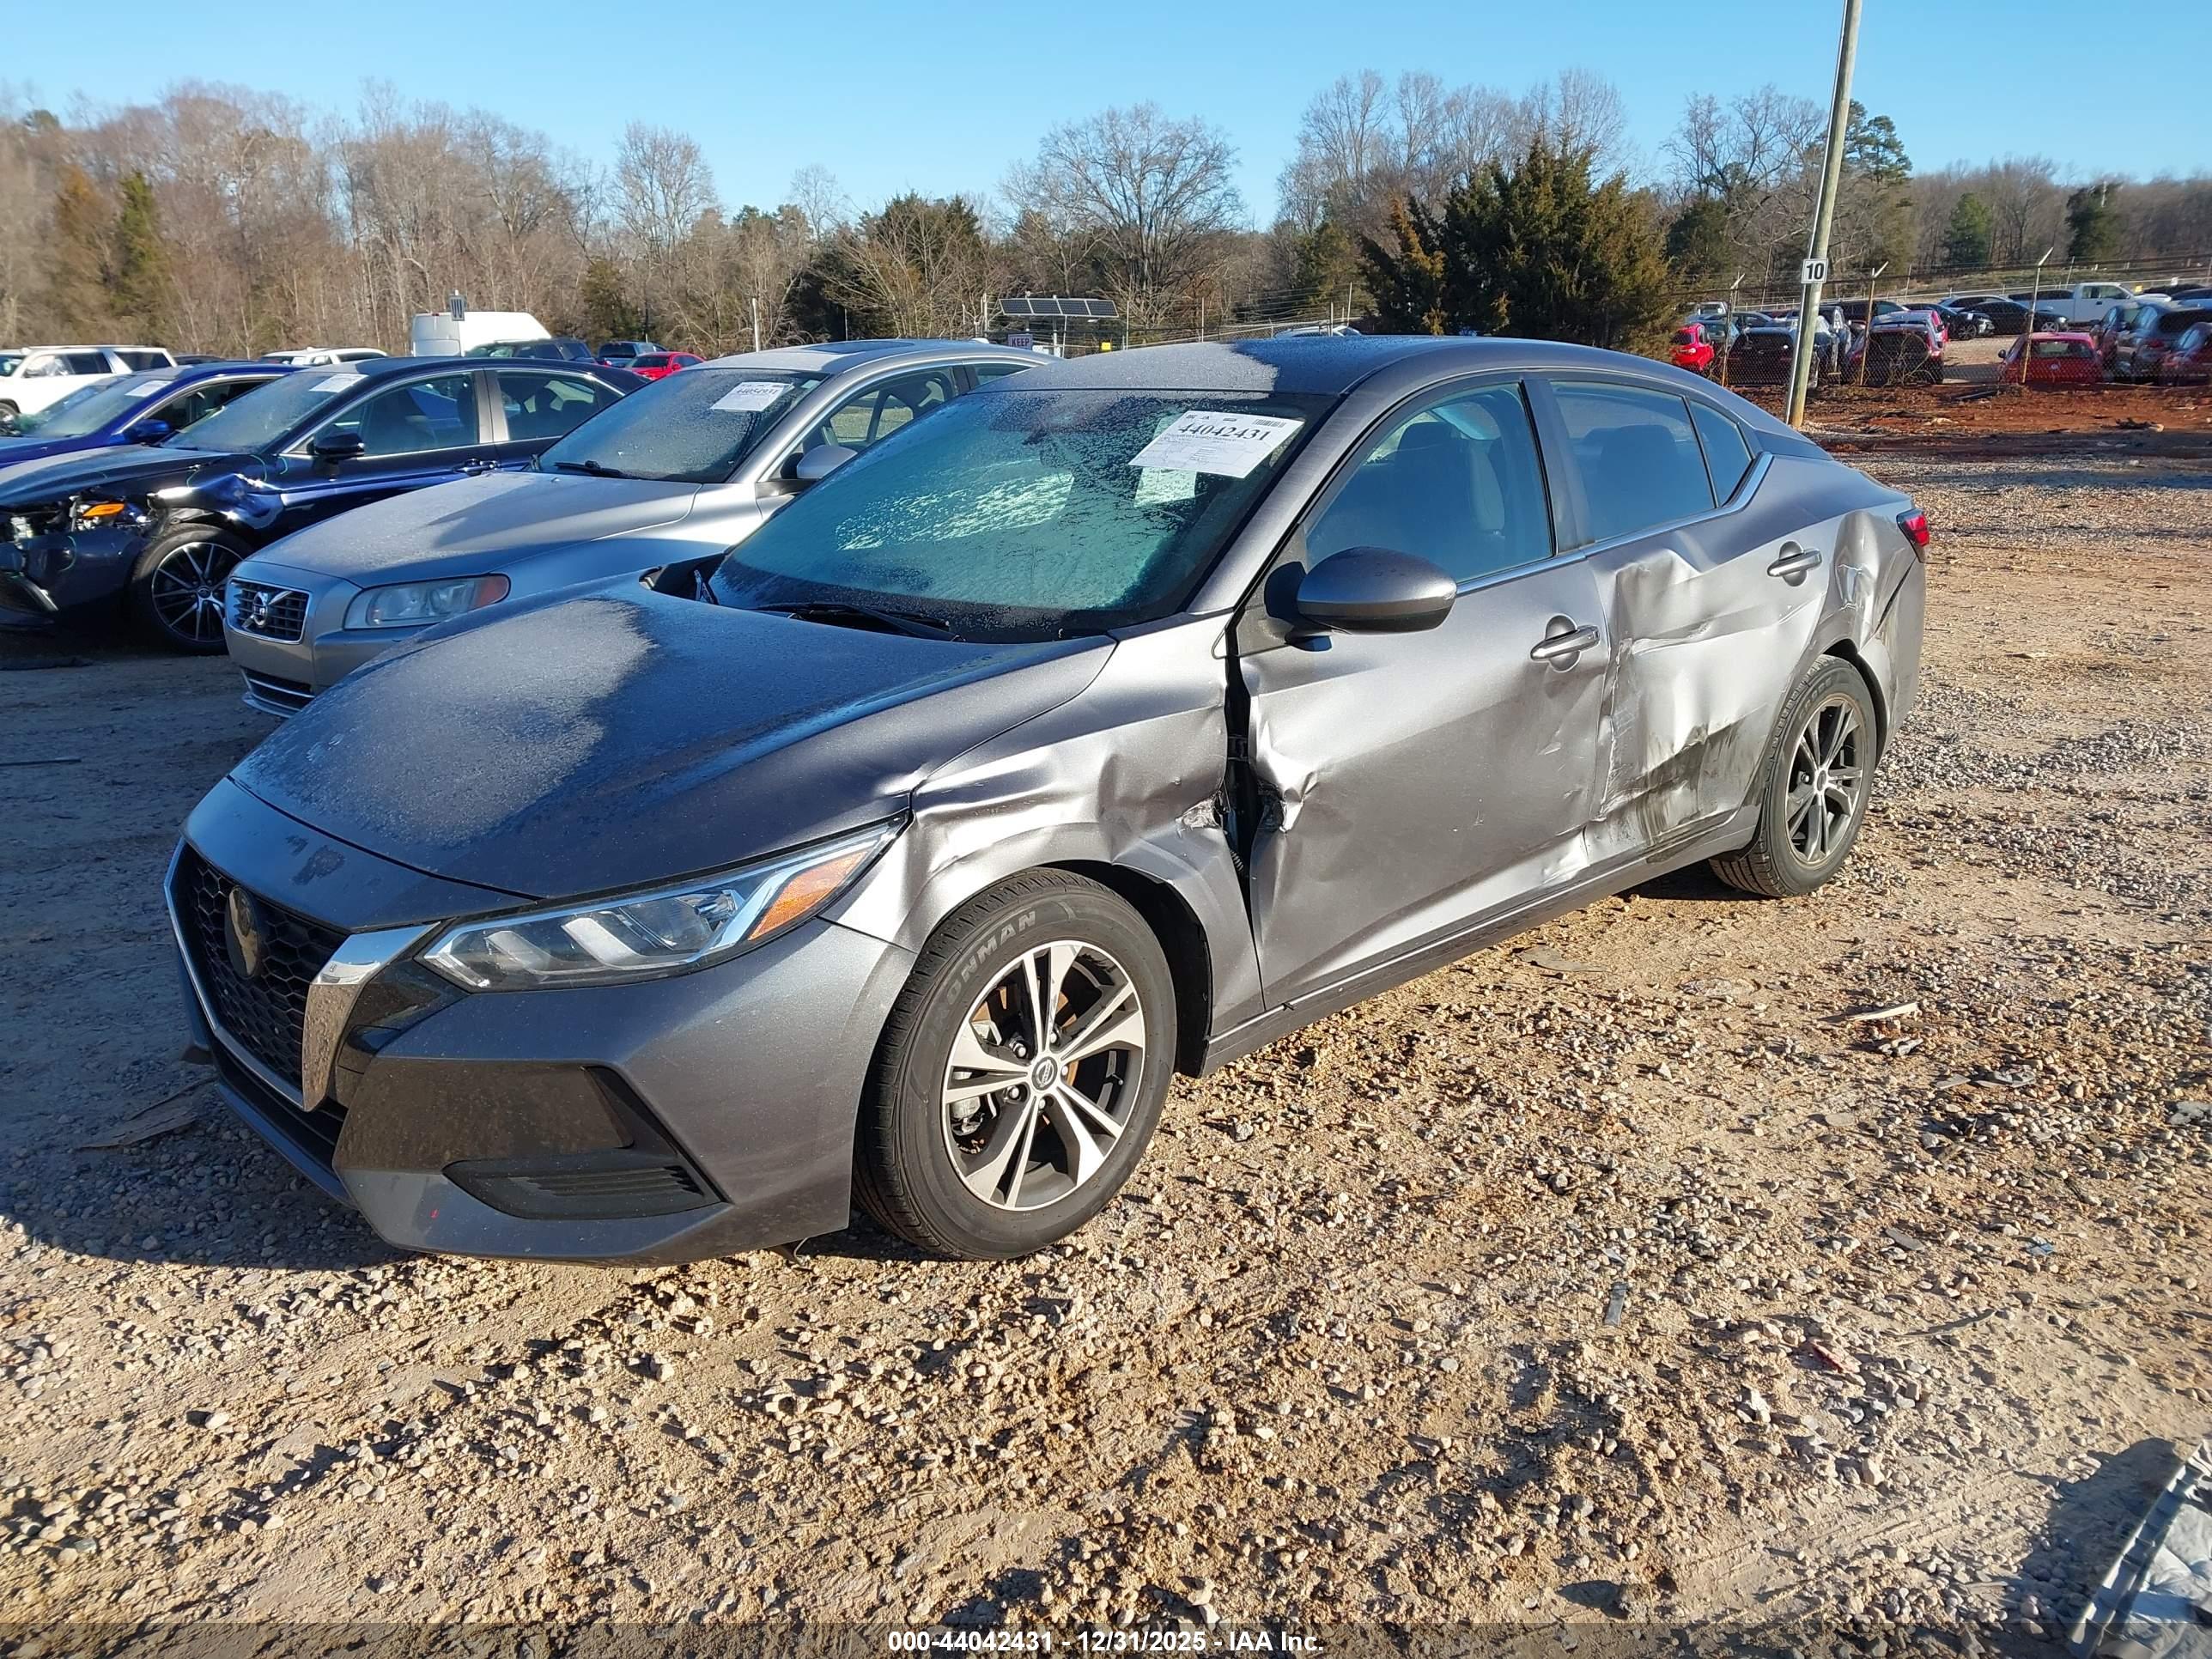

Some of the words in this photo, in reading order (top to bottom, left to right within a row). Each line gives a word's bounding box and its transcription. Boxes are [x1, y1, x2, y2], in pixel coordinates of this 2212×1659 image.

[1806, 263, 1825, 280] 10
[1012, 337, 1030, 347] KEEP
[1177, 423, 1272, 441] 44042431
